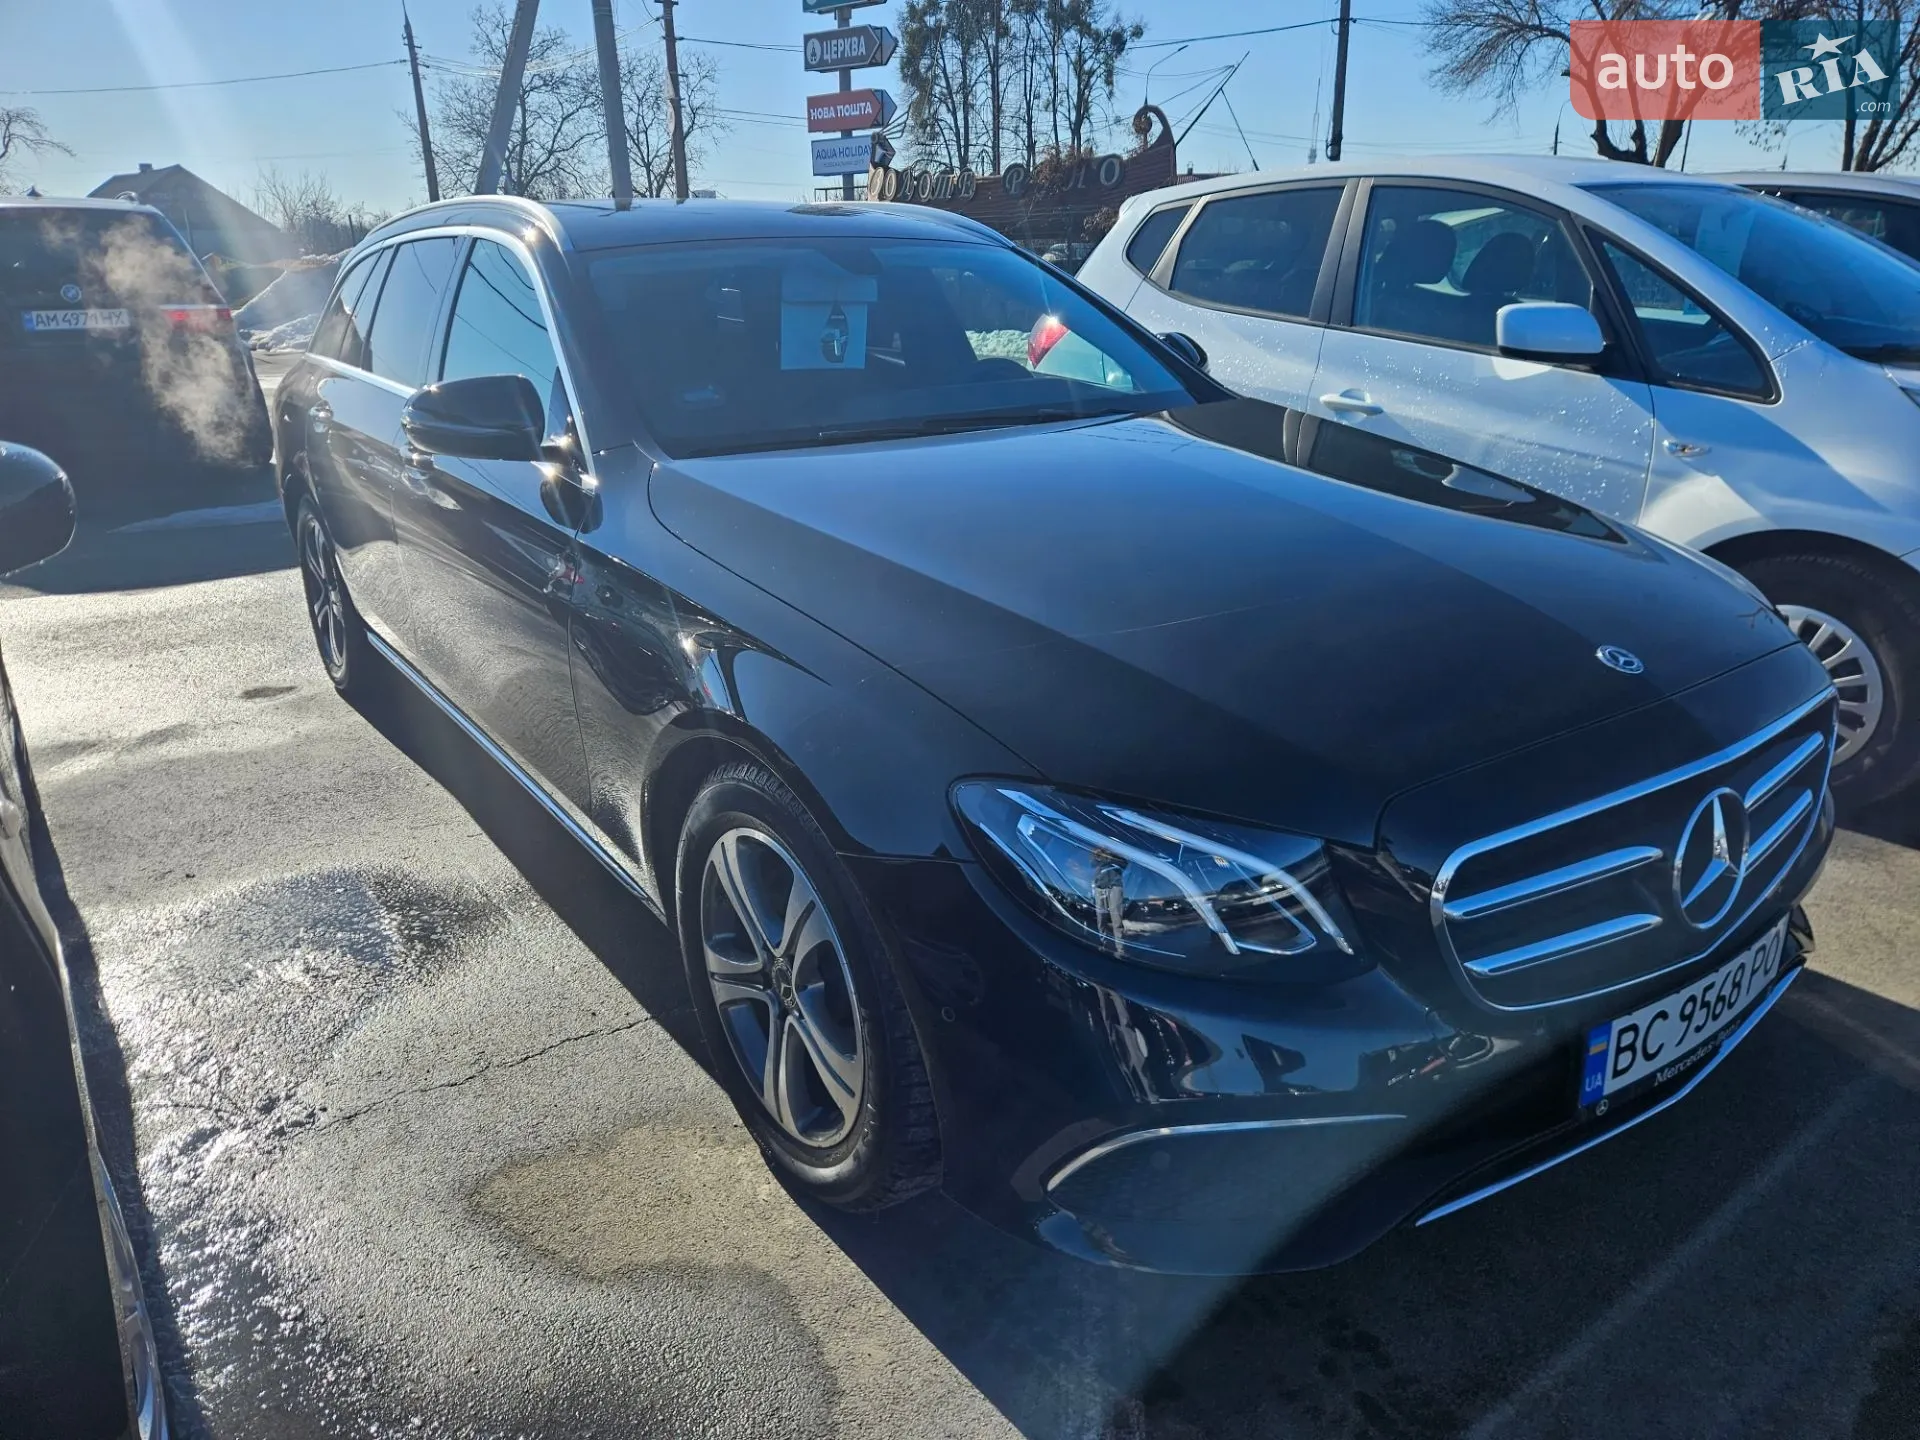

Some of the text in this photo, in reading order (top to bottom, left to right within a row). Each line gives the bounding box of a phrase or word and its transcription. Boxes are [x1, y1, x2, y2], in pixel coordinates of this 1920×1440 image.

[823, 35, 867, 63] ЦЕРКВА
[810, 101, 873, 121] НОВА ПОШТА
[815, 147, 837, 161] AQUA
[1005, 157, 1121, 195] РНО
[35, 312, 60, 327] AM
[1611, 930, 1781, 1080] BC 9568 PO
[1585, 1072, 1604, 1092] UA
